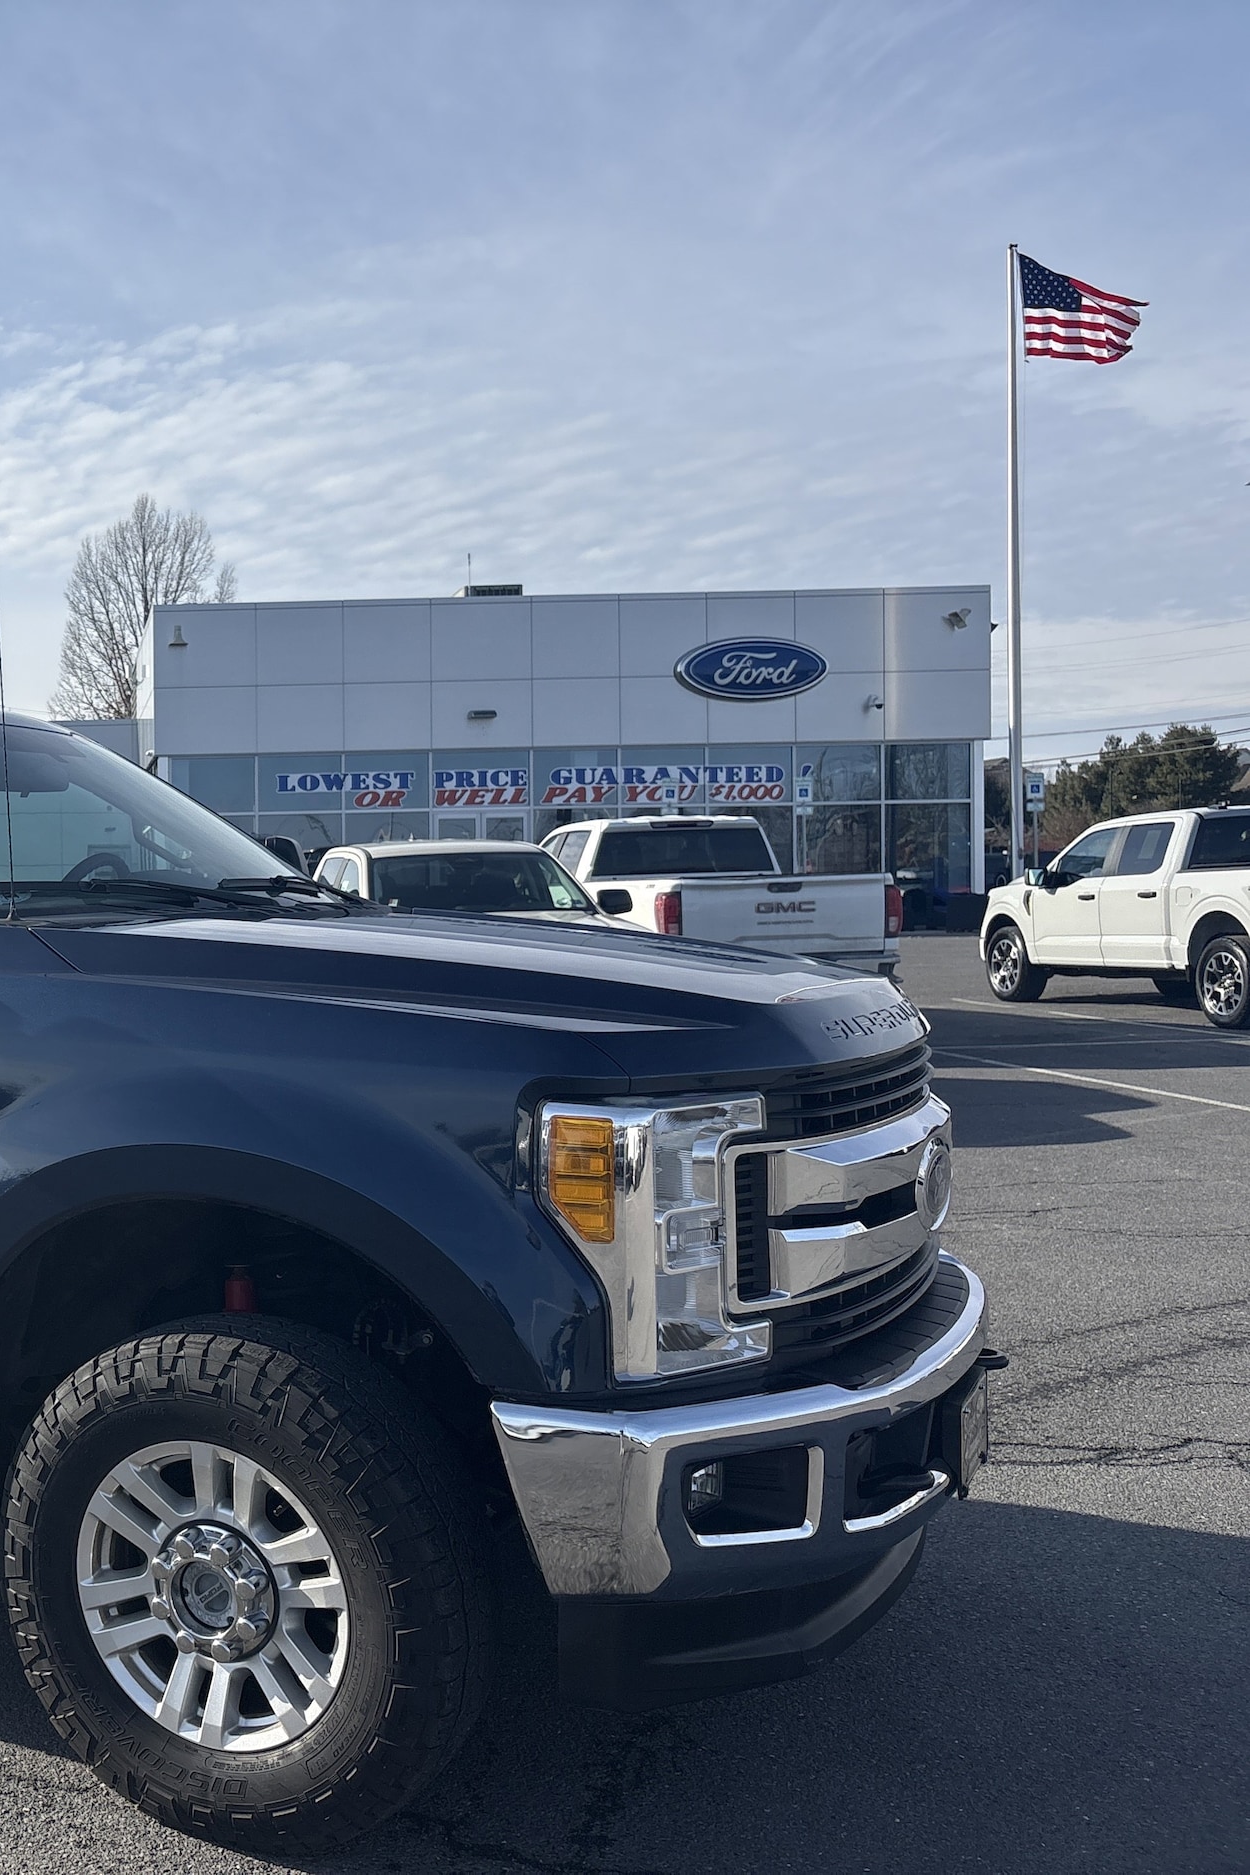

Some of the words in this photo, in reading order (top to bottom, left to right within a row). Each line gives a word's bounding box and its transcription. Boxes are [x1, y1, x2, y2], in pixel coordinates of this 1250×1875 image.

[713, 651, 797, 685] Ford
[276, 772, 414, 792] LOWEST
[434, 769, 527, 788] PRICE
[354, 791, 406, 807] OR
[541, 786, 614, 803] PAY
[708, 784, 784, 801] $1,000
[755, 901, 816, 913] GMC
[227, 1416, 368, 1570] COOPER
